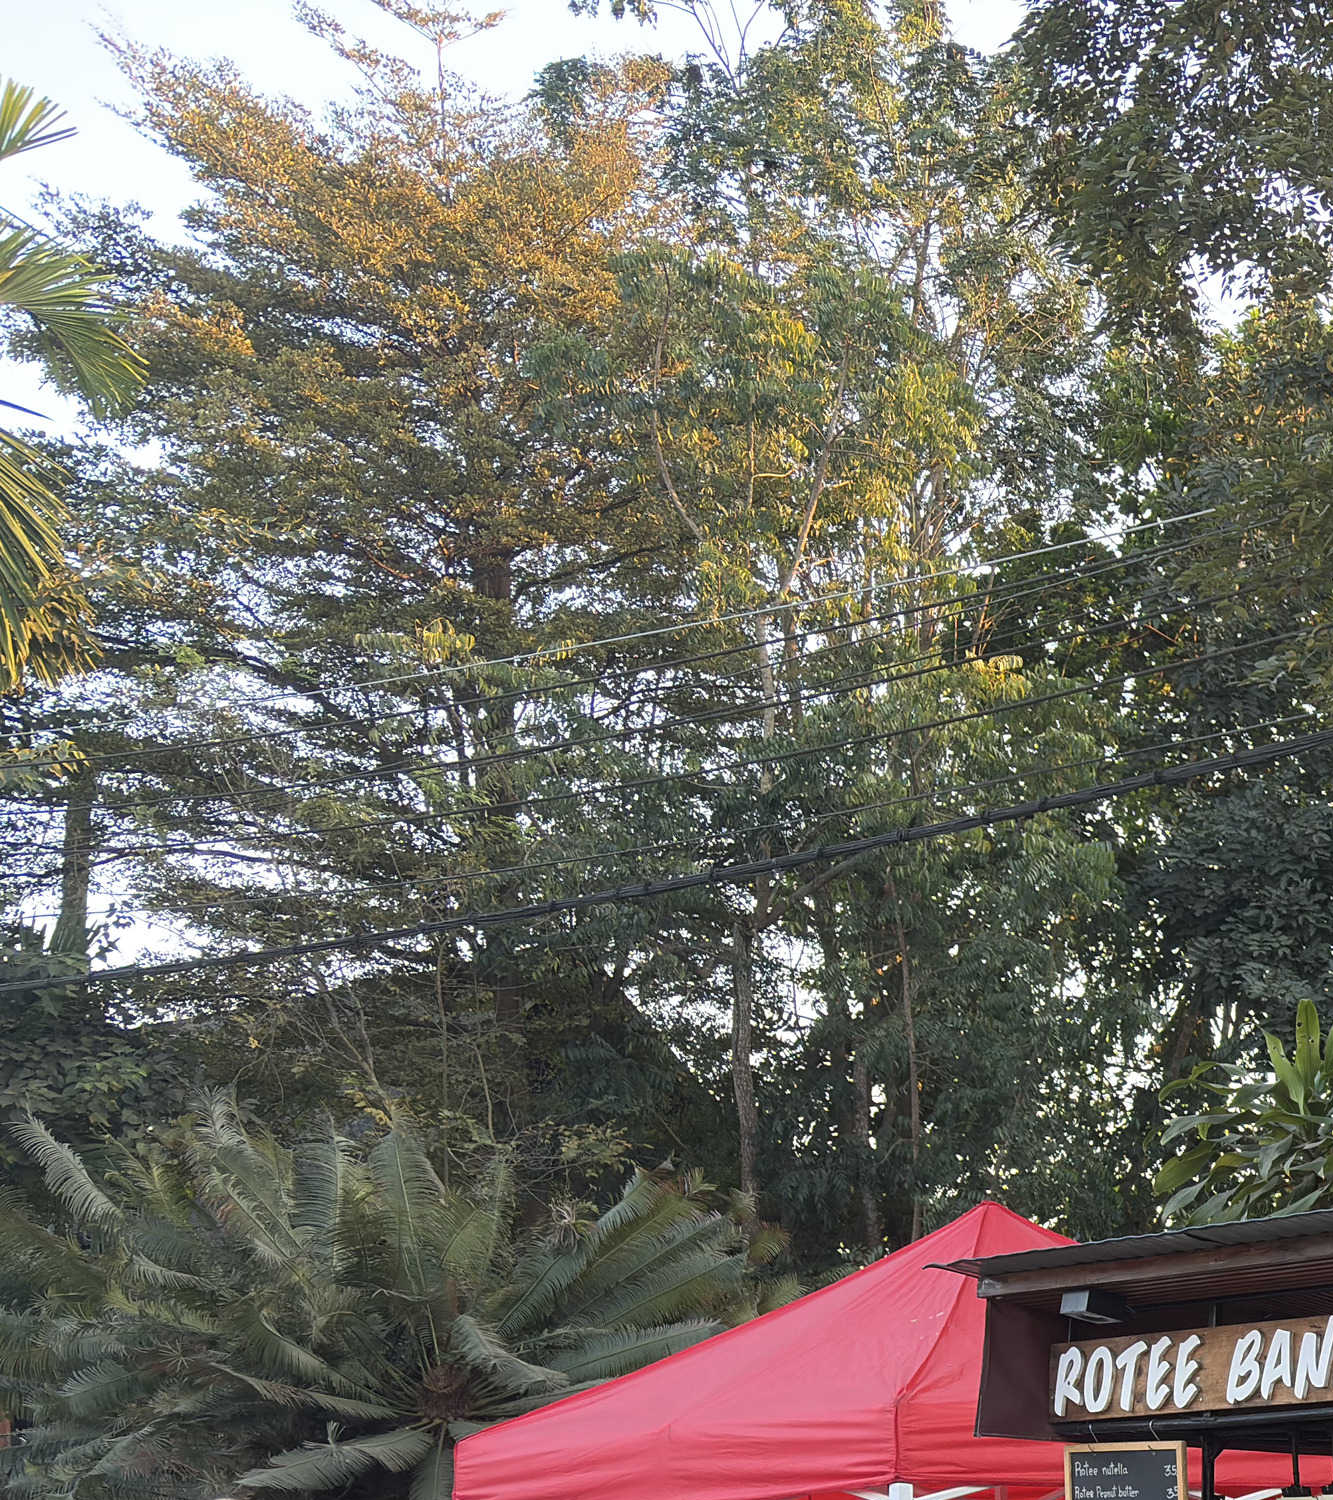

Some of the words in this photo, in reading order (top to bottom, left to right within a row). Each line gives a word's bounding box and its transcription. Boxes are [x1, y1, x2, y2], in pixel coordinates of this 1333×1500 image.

[1053, 1334, 1202, 1417] ROTEE
[1075, 1461, 1098, 1477] Rotee
[1102, 1461, 1128, 1476] nutella
[1075, 1486, 1094, 1499] Rotee
[1118, 1485, 1139, 1498] butter
